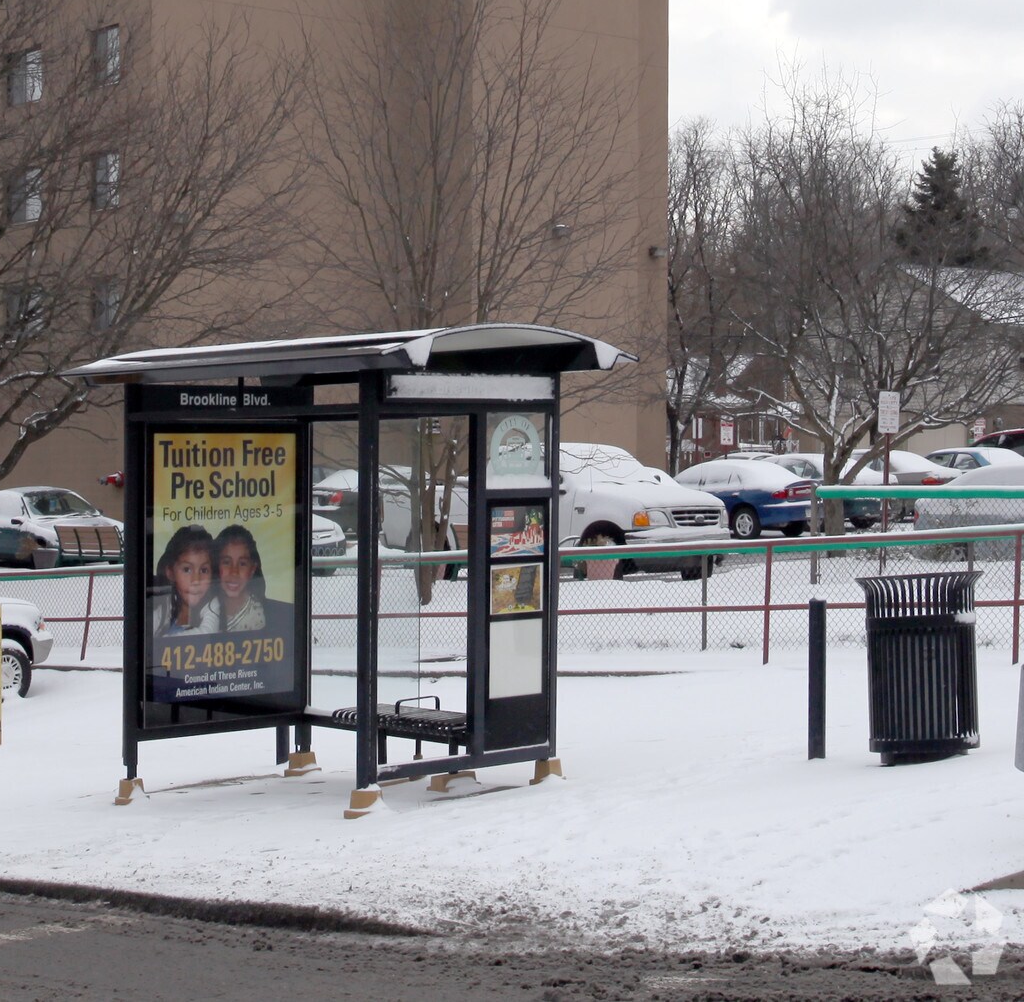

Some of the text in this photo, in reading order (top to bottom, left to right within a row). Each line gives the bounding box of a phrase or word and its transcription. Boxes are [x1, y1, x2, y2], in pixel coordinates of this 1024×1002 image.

[180, 393, 271, 406] Brookline Blvd.
[159, 439, 286, 468] Tuition Free
[171, 470, 275, 499] Pre School
[162, 507, 182, 521] For
[184, 506, 230, 521] Children
[233, 505, 261, 522] Ages
[161, 637, 284, 671] 412-488-2750
[184, 669, 258, 684] Council of Three Rivers
[176, 681, 265, 697] American Indian Center, Inc.
